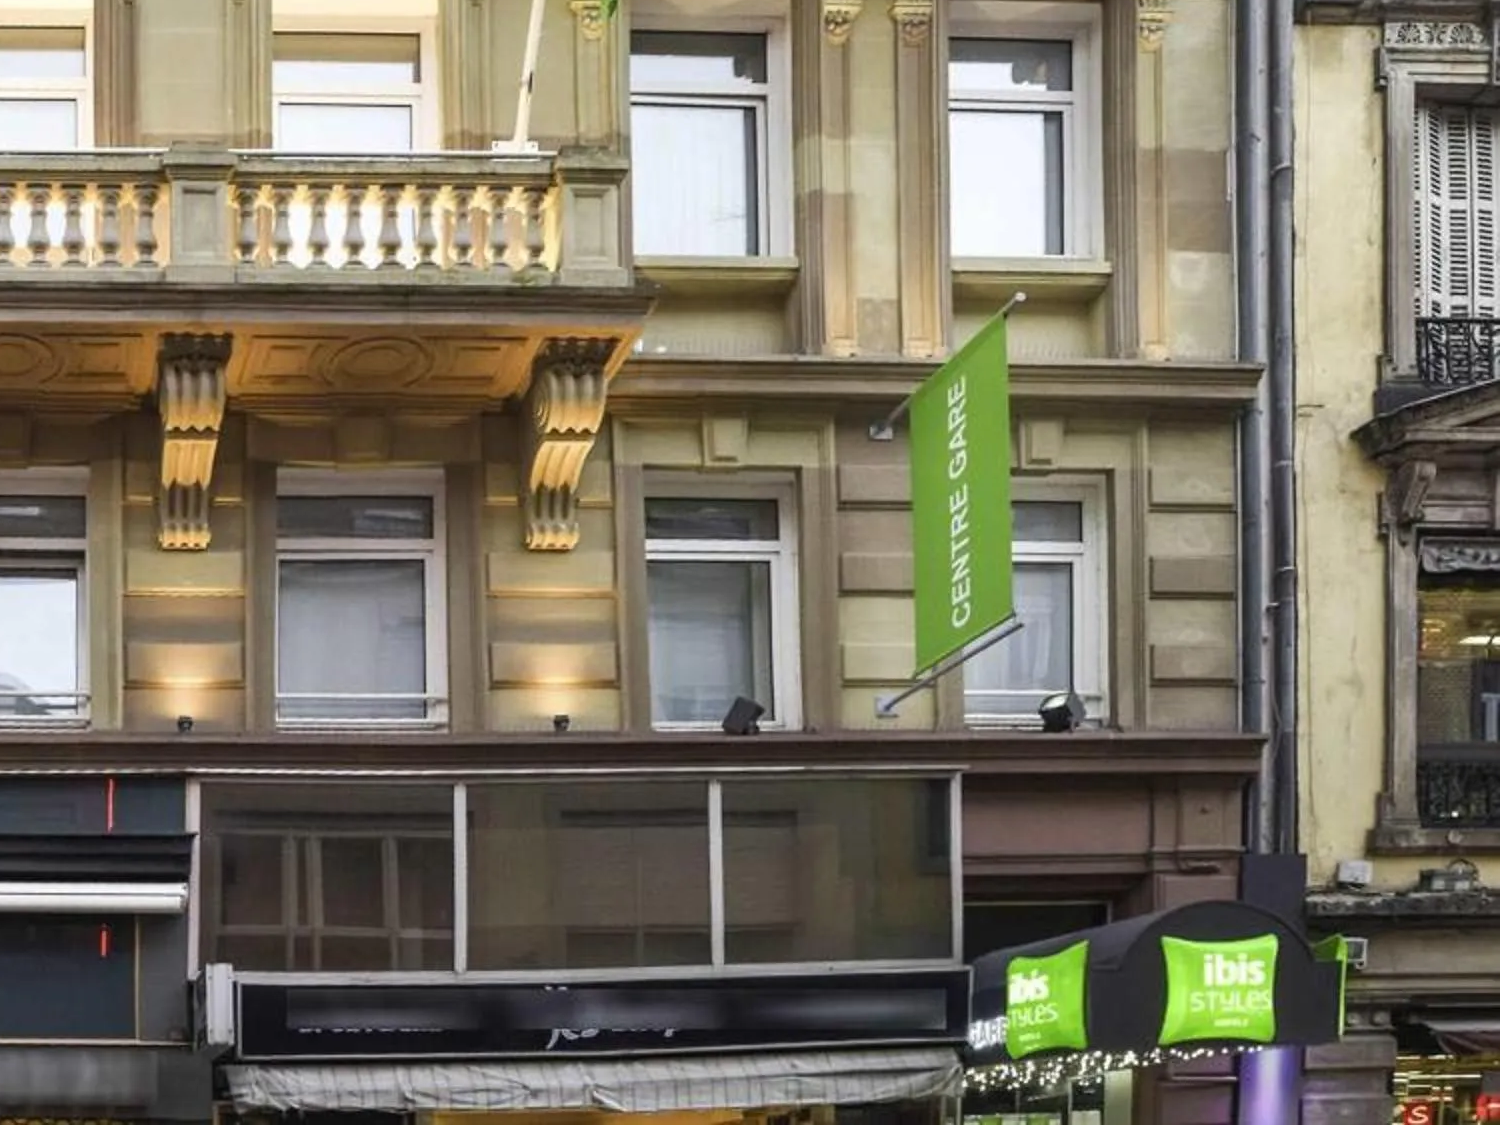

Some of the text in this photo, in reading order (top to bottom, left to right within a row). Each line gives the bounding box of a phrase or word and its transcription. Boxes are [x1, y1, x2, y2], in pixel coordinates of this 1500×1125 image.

[947, 375, 971, 629] CENTRE GARE
[1203, 953, 1266, 987] ibis
[1190, 989, 1274, 1015] STYLES
